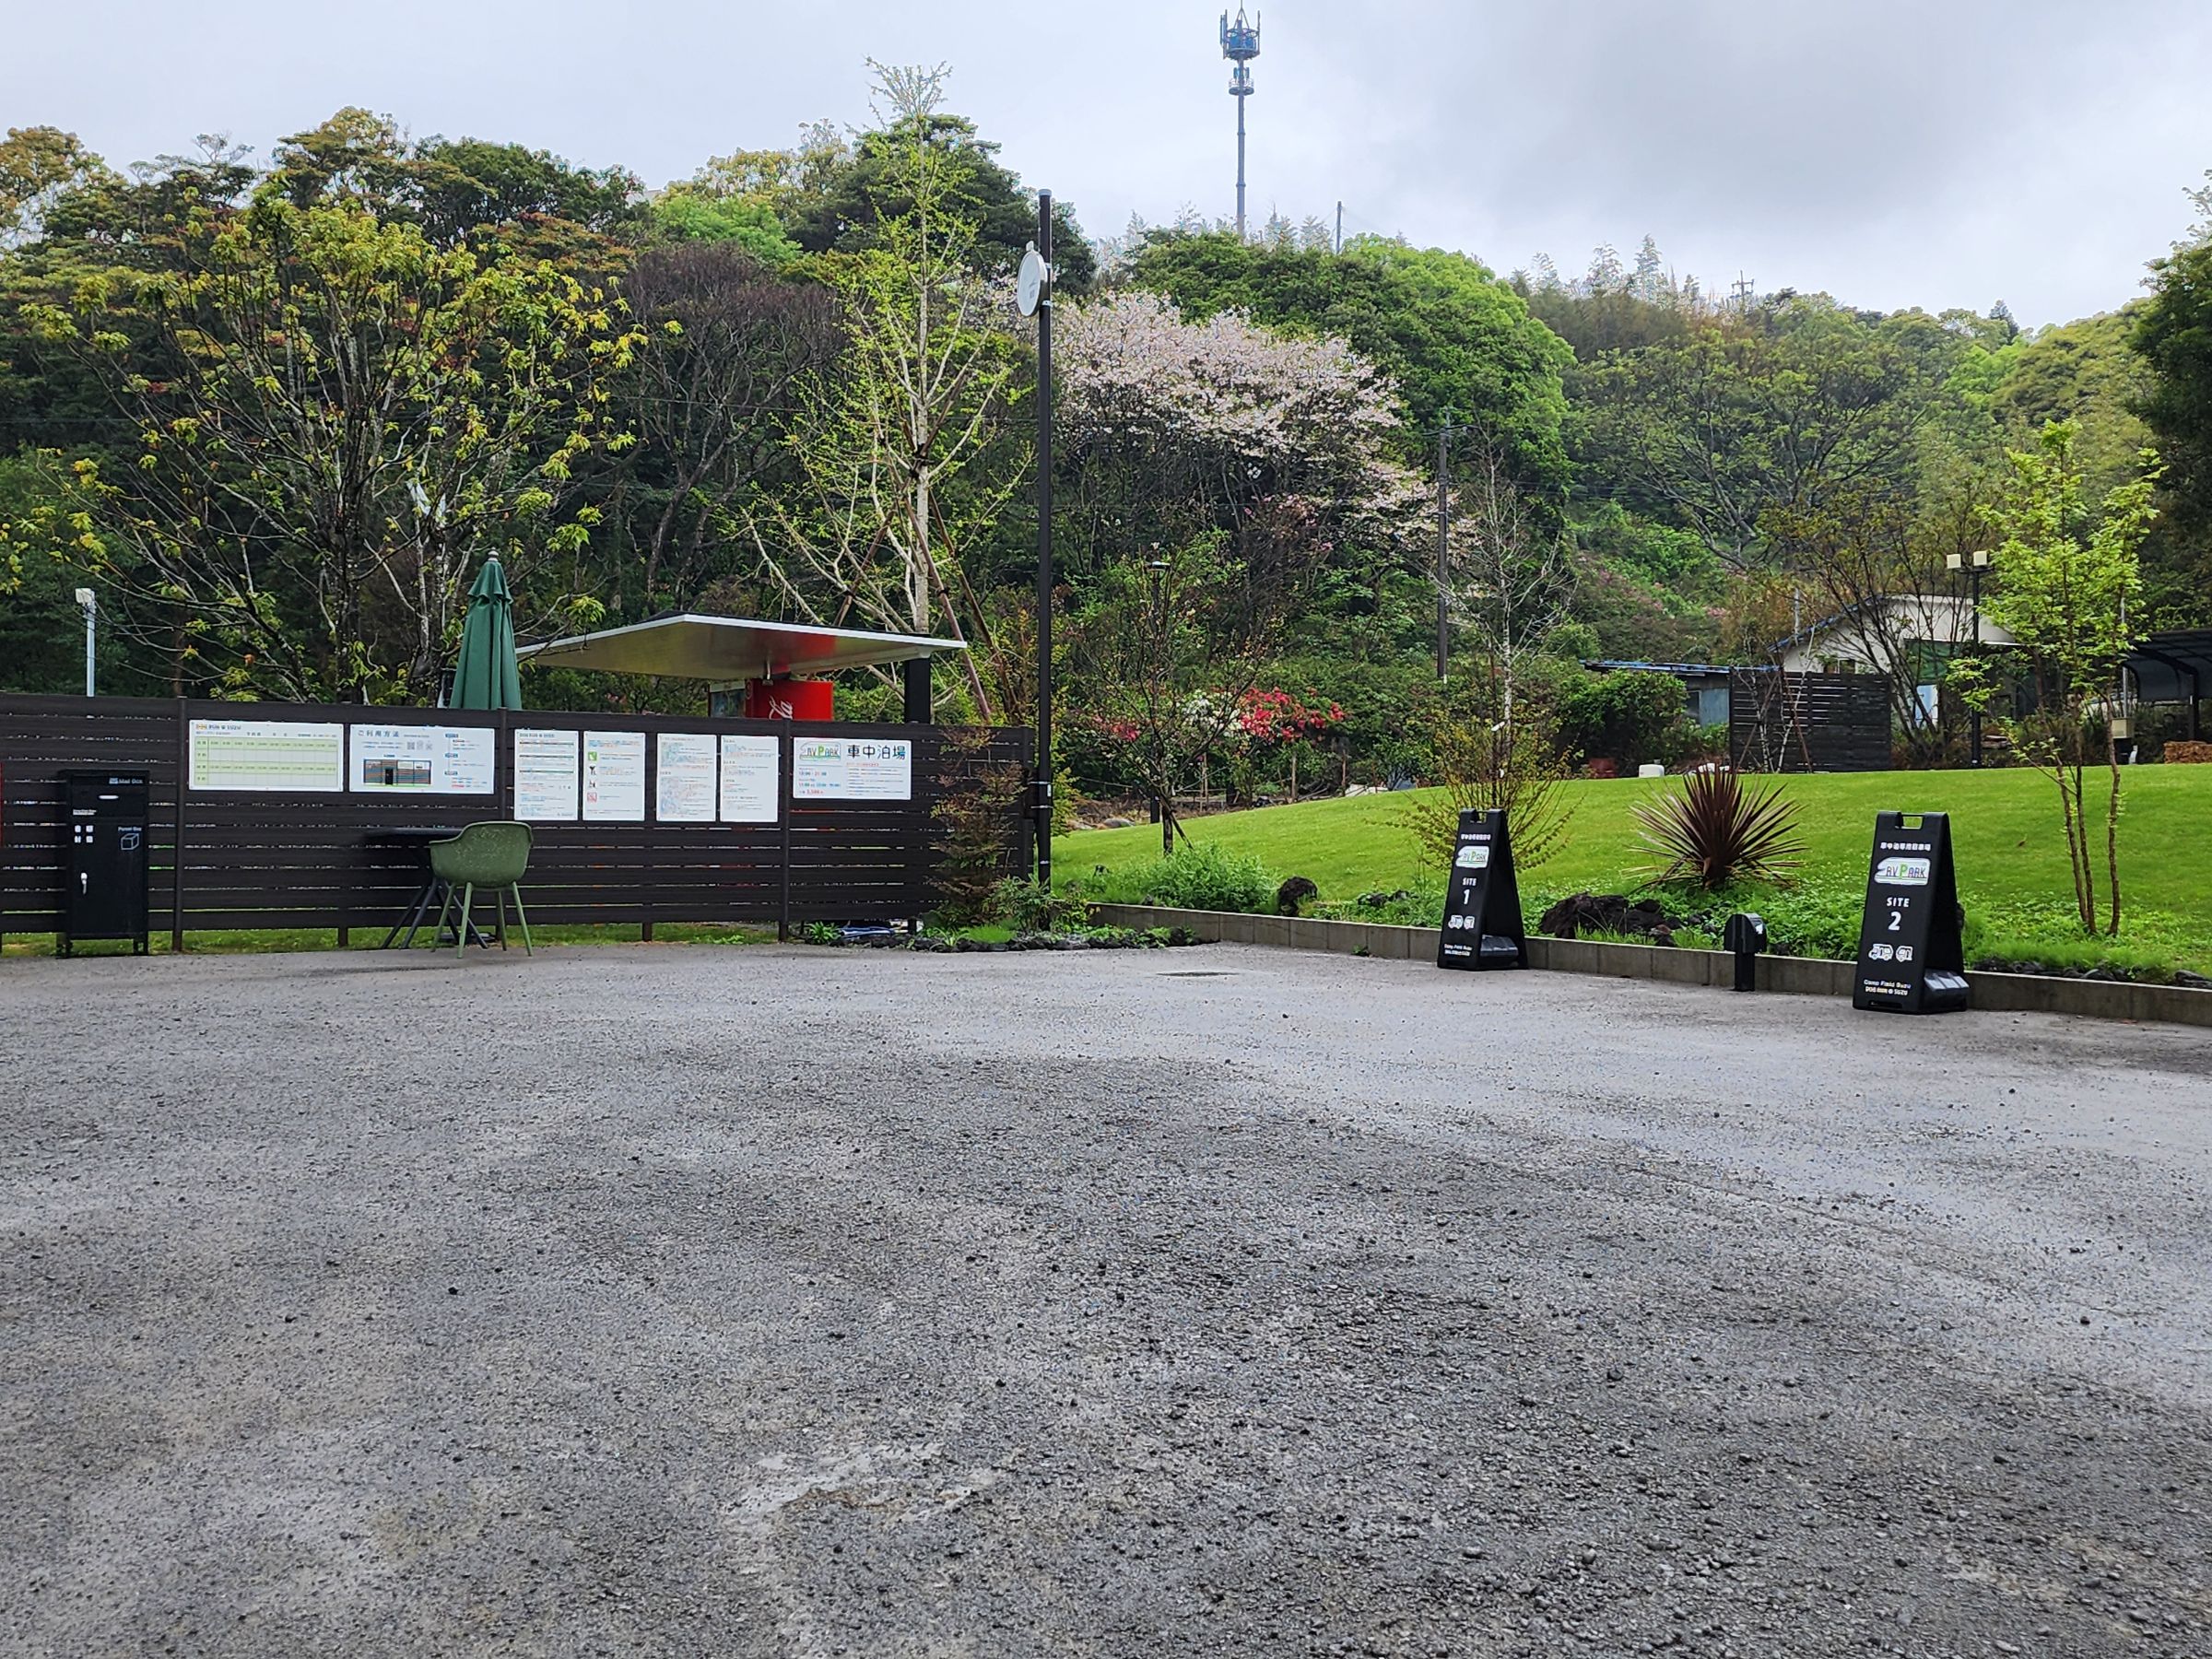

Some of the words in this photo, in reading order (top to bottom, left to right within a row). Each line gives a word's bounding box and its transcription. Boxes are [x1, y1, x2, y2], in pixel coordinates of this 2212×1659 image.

[847, 745, 906, 760] 車中泊場
[1462, 877, 1477, 886] SITE
[1463, 888, 1470, 905] 1
[1886, 897, 1911, 908] SITE
[1888, 911, 1902, 931] 2
